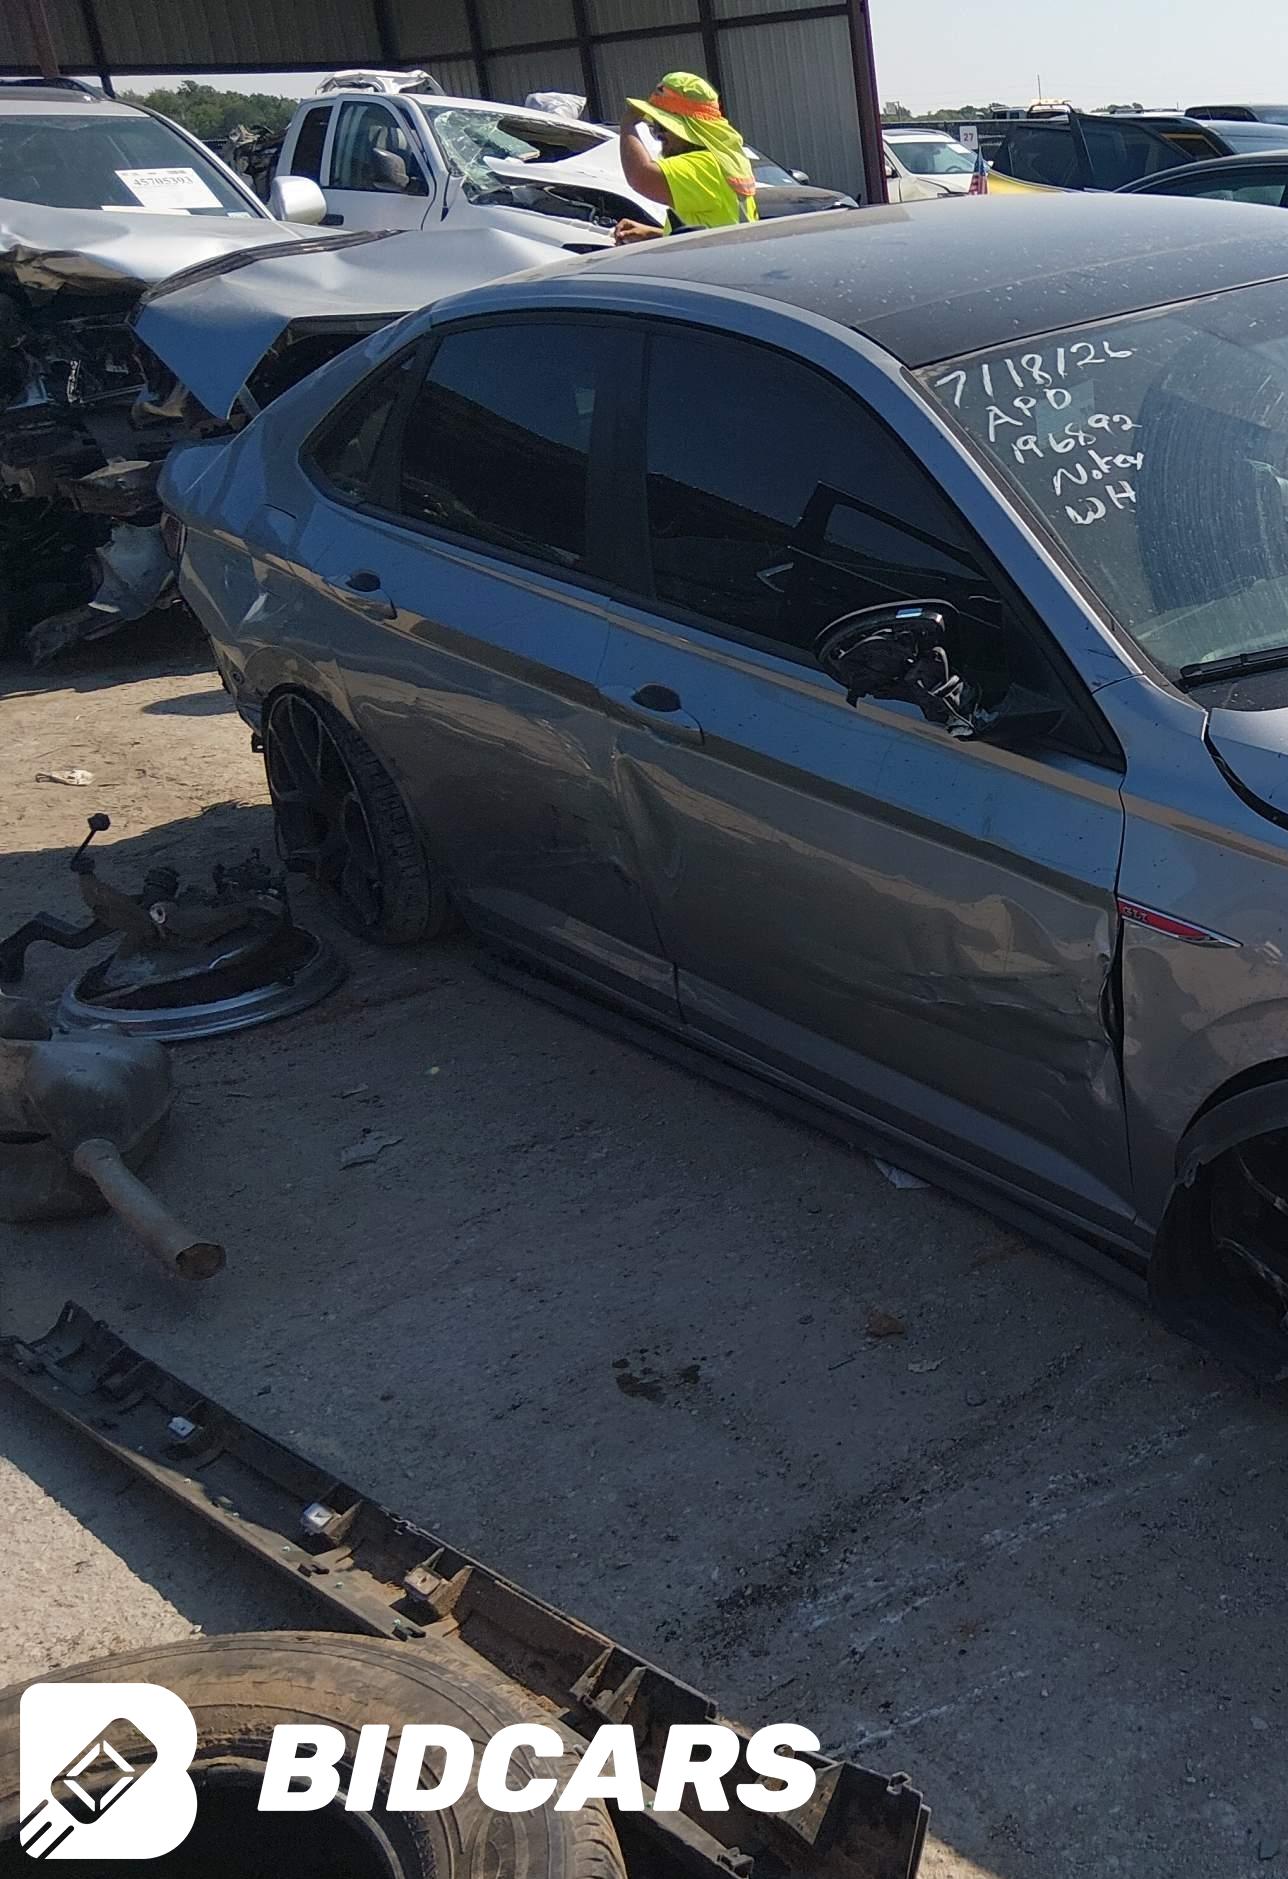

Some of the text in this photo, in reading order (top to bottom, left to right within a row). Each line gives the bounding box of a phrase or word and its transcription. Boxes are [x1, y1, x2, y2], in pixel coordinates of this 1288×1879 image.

[963, 132, 974, 142] 27
[985, 388, 1072, 442] APD
[1011, 413, 1142, 464] 196892
[1065, 480, 1137, 525] WH
